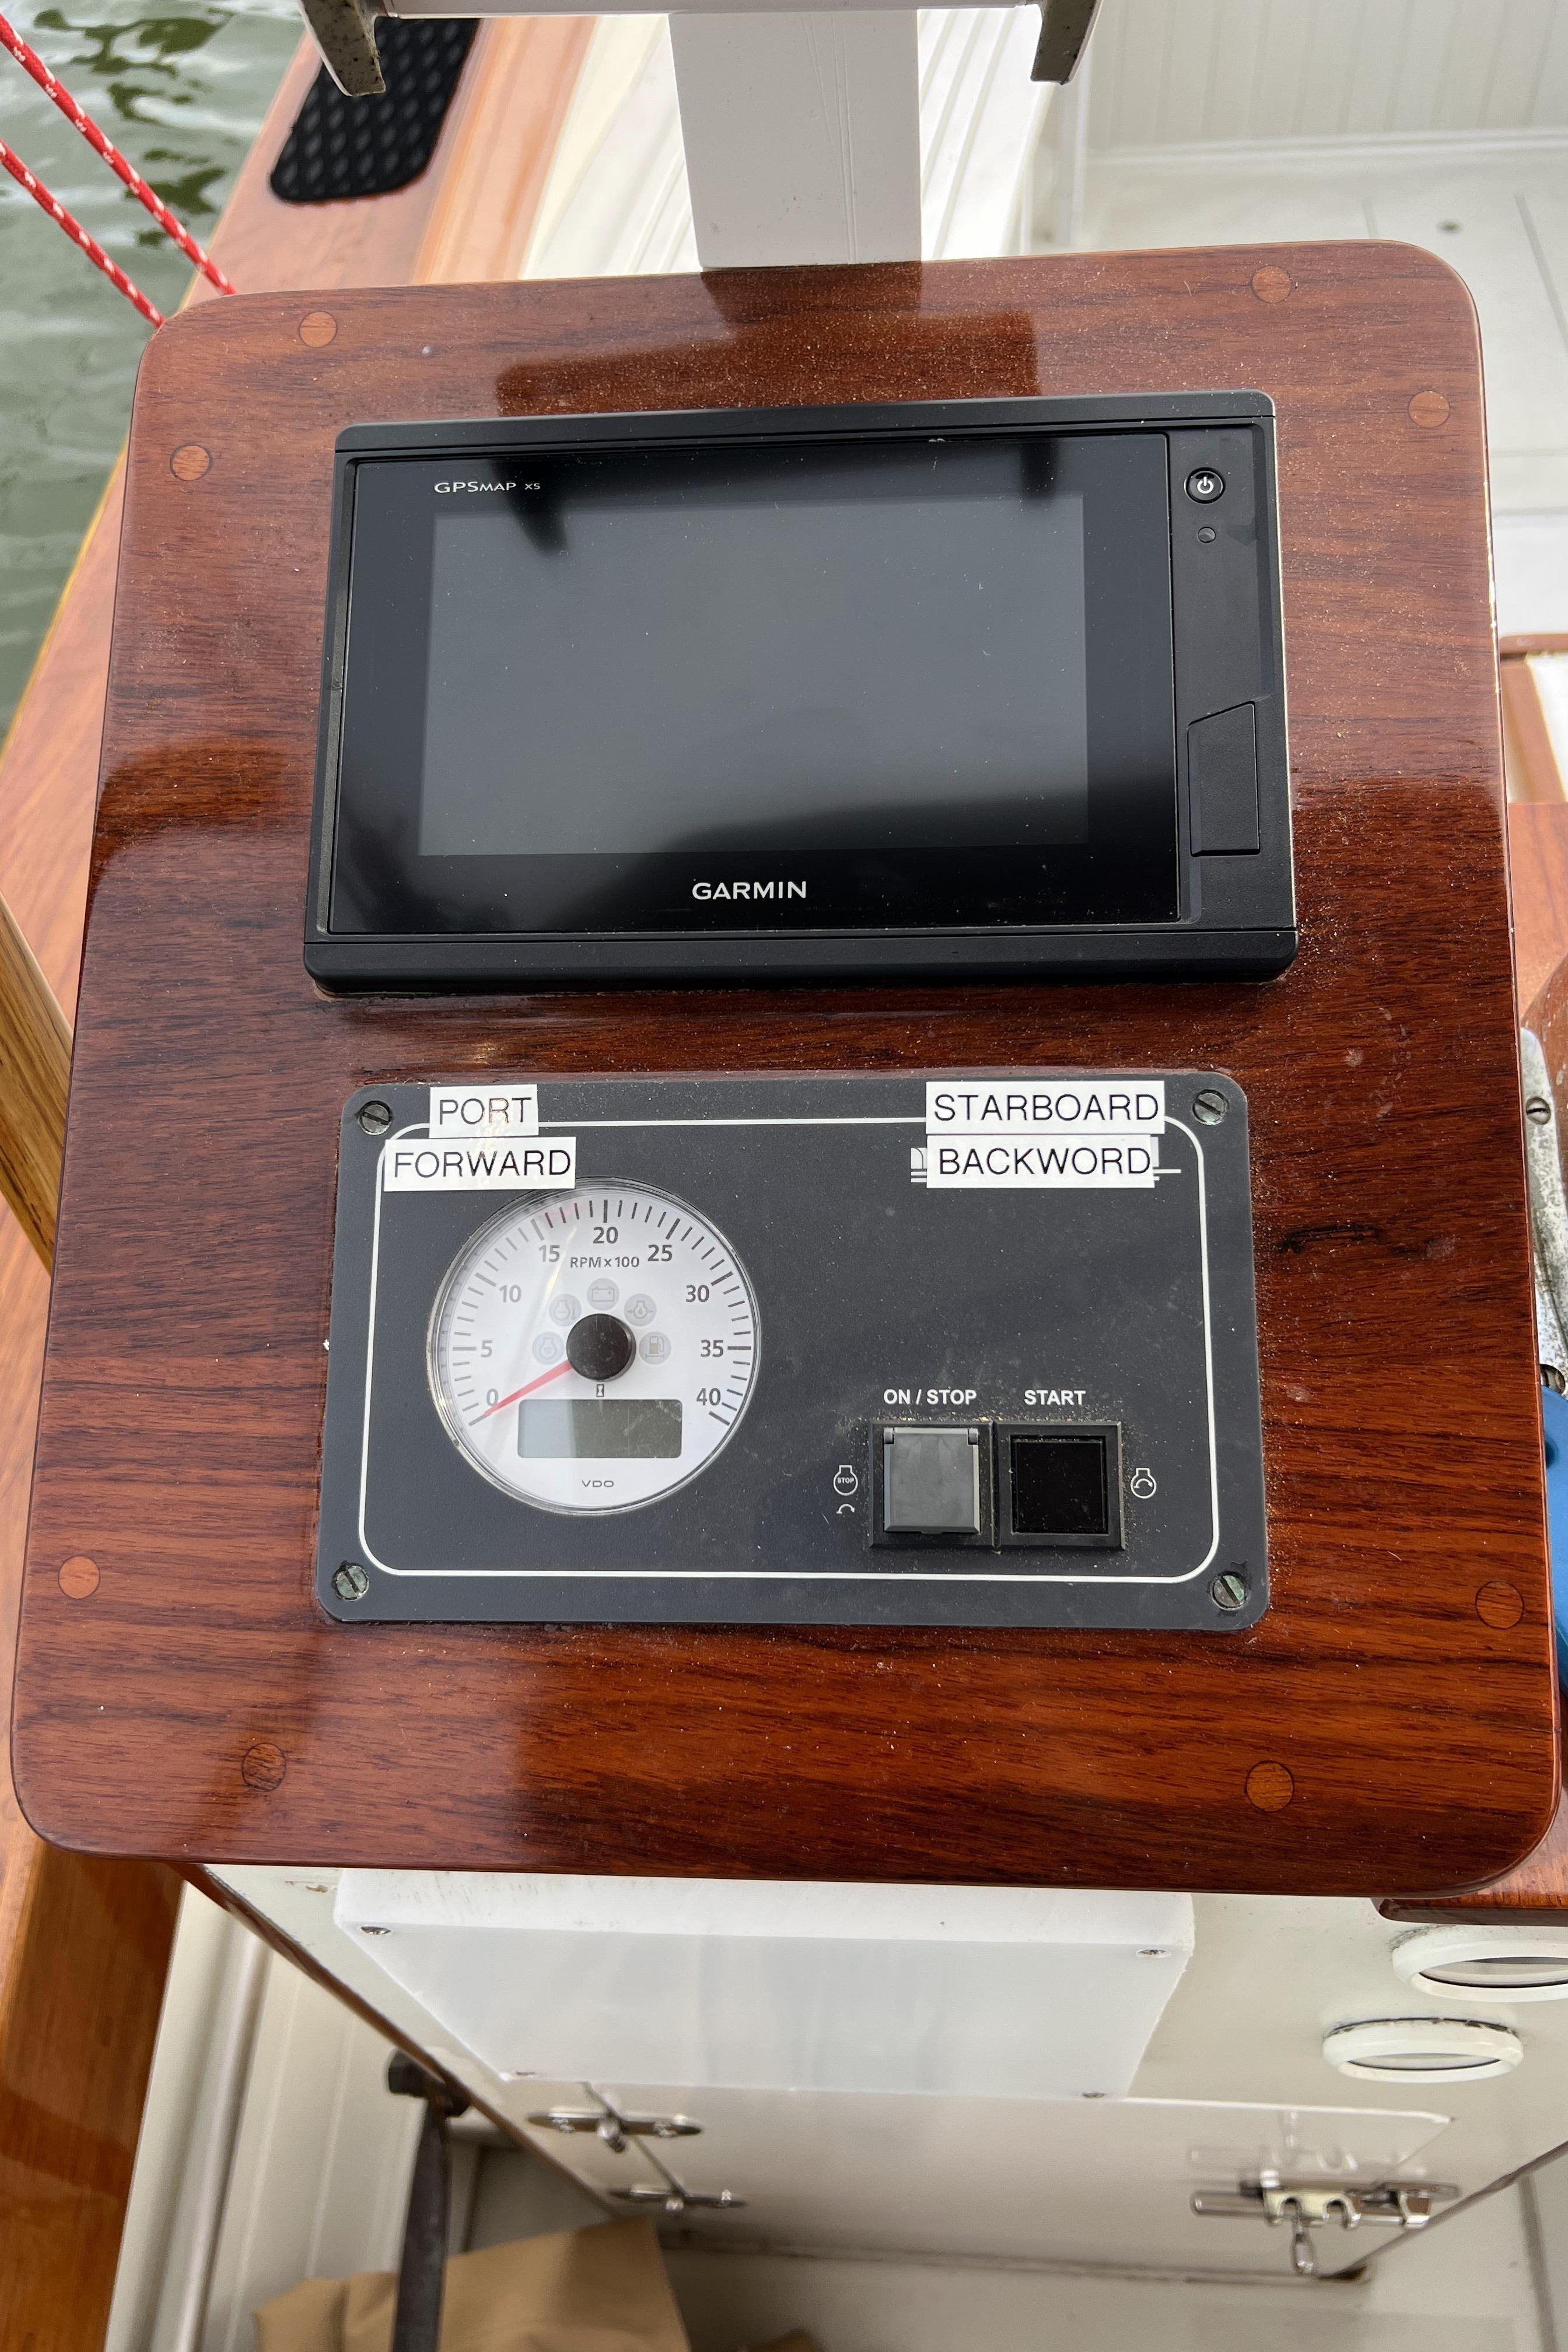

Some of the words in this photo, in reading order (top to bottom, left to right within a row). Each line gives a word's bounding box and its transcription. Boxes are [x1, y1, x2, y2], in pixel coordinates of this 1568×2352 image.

[692, 881, 806, 900] GARMIN
[439, 1097, 531, 1125] PORT
[934, 1094, 1158, 1121] STARBOARD
[395, 1150, 570, 1178] FORWARD
[939, 1147, 1150, 1175] BACKWORD
[593, 1226, 618, 1244] 20
[538, 1244, 560, 1262] 15
[648, 1244, 673, 1262] 25
[499, 1285, 522, 1303] 10
[685, 1285, 709, 1303] 30
[481, 1340, 493, 1357] 5
[700, 1340, 724, 1358] 35
[486, 1388, 499, 1407] 0
[696, 1388, 722, 1406] 40
[883, 1389, 911, 1405] ON
[926, 1388, 977, 1405] STOP
[1024, 1390, 1086, 1406] START
[582, 1480, 615, 1488] VDO
